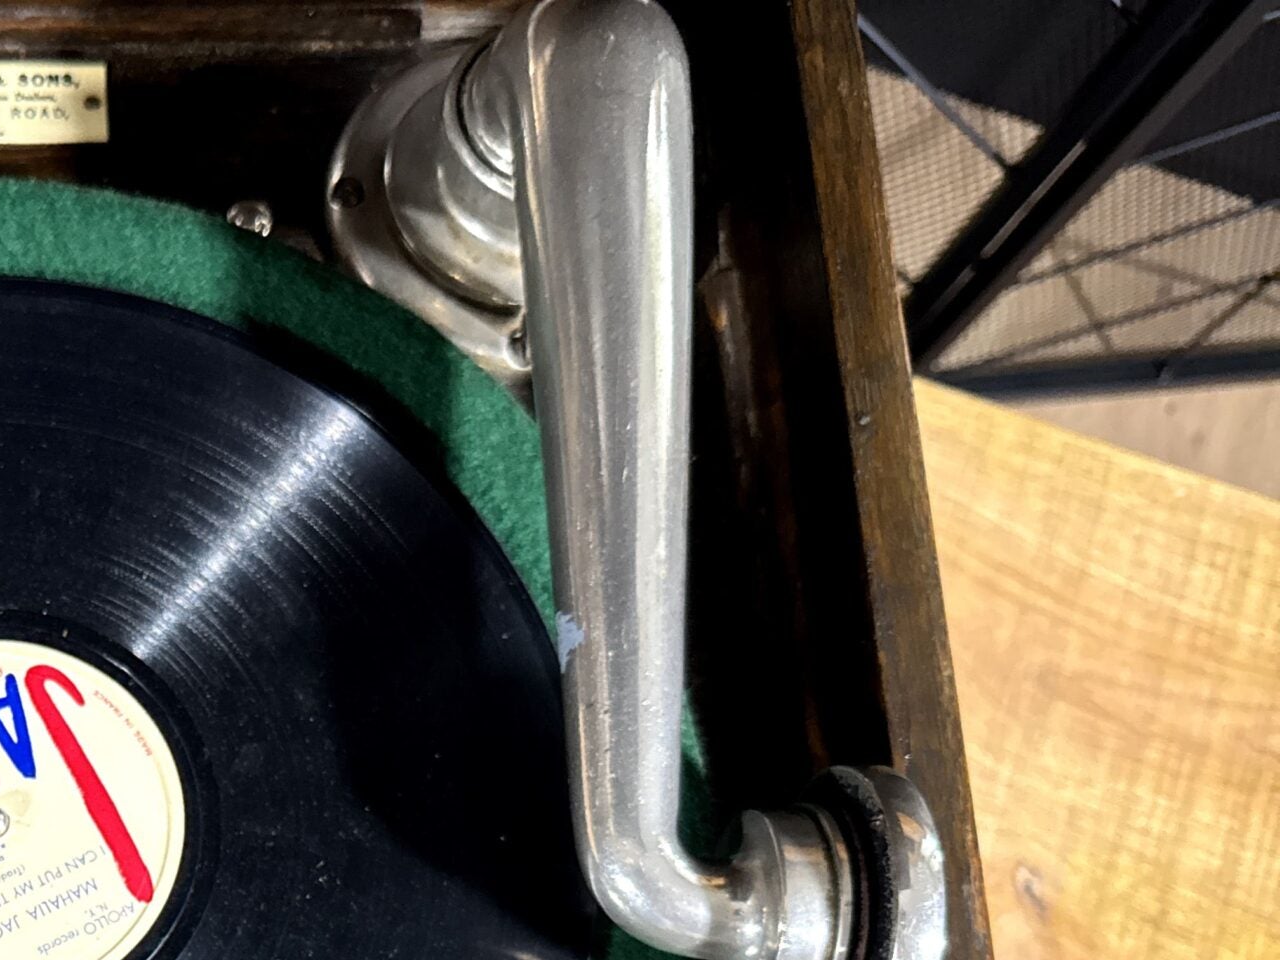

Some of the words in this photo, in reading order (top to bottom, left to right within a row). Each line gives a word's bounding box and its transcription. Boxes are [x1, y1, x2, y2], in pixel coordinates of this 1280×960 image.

[64, 850, 98, 873] CAN
[12, 880, 34, 899] MY
[37, 867, 63, 887] PUT
[25, 878, 98, 920] MAHALIA
[83, 902, 135, 935] APOLLO
[37, 929, 80, 956] records
